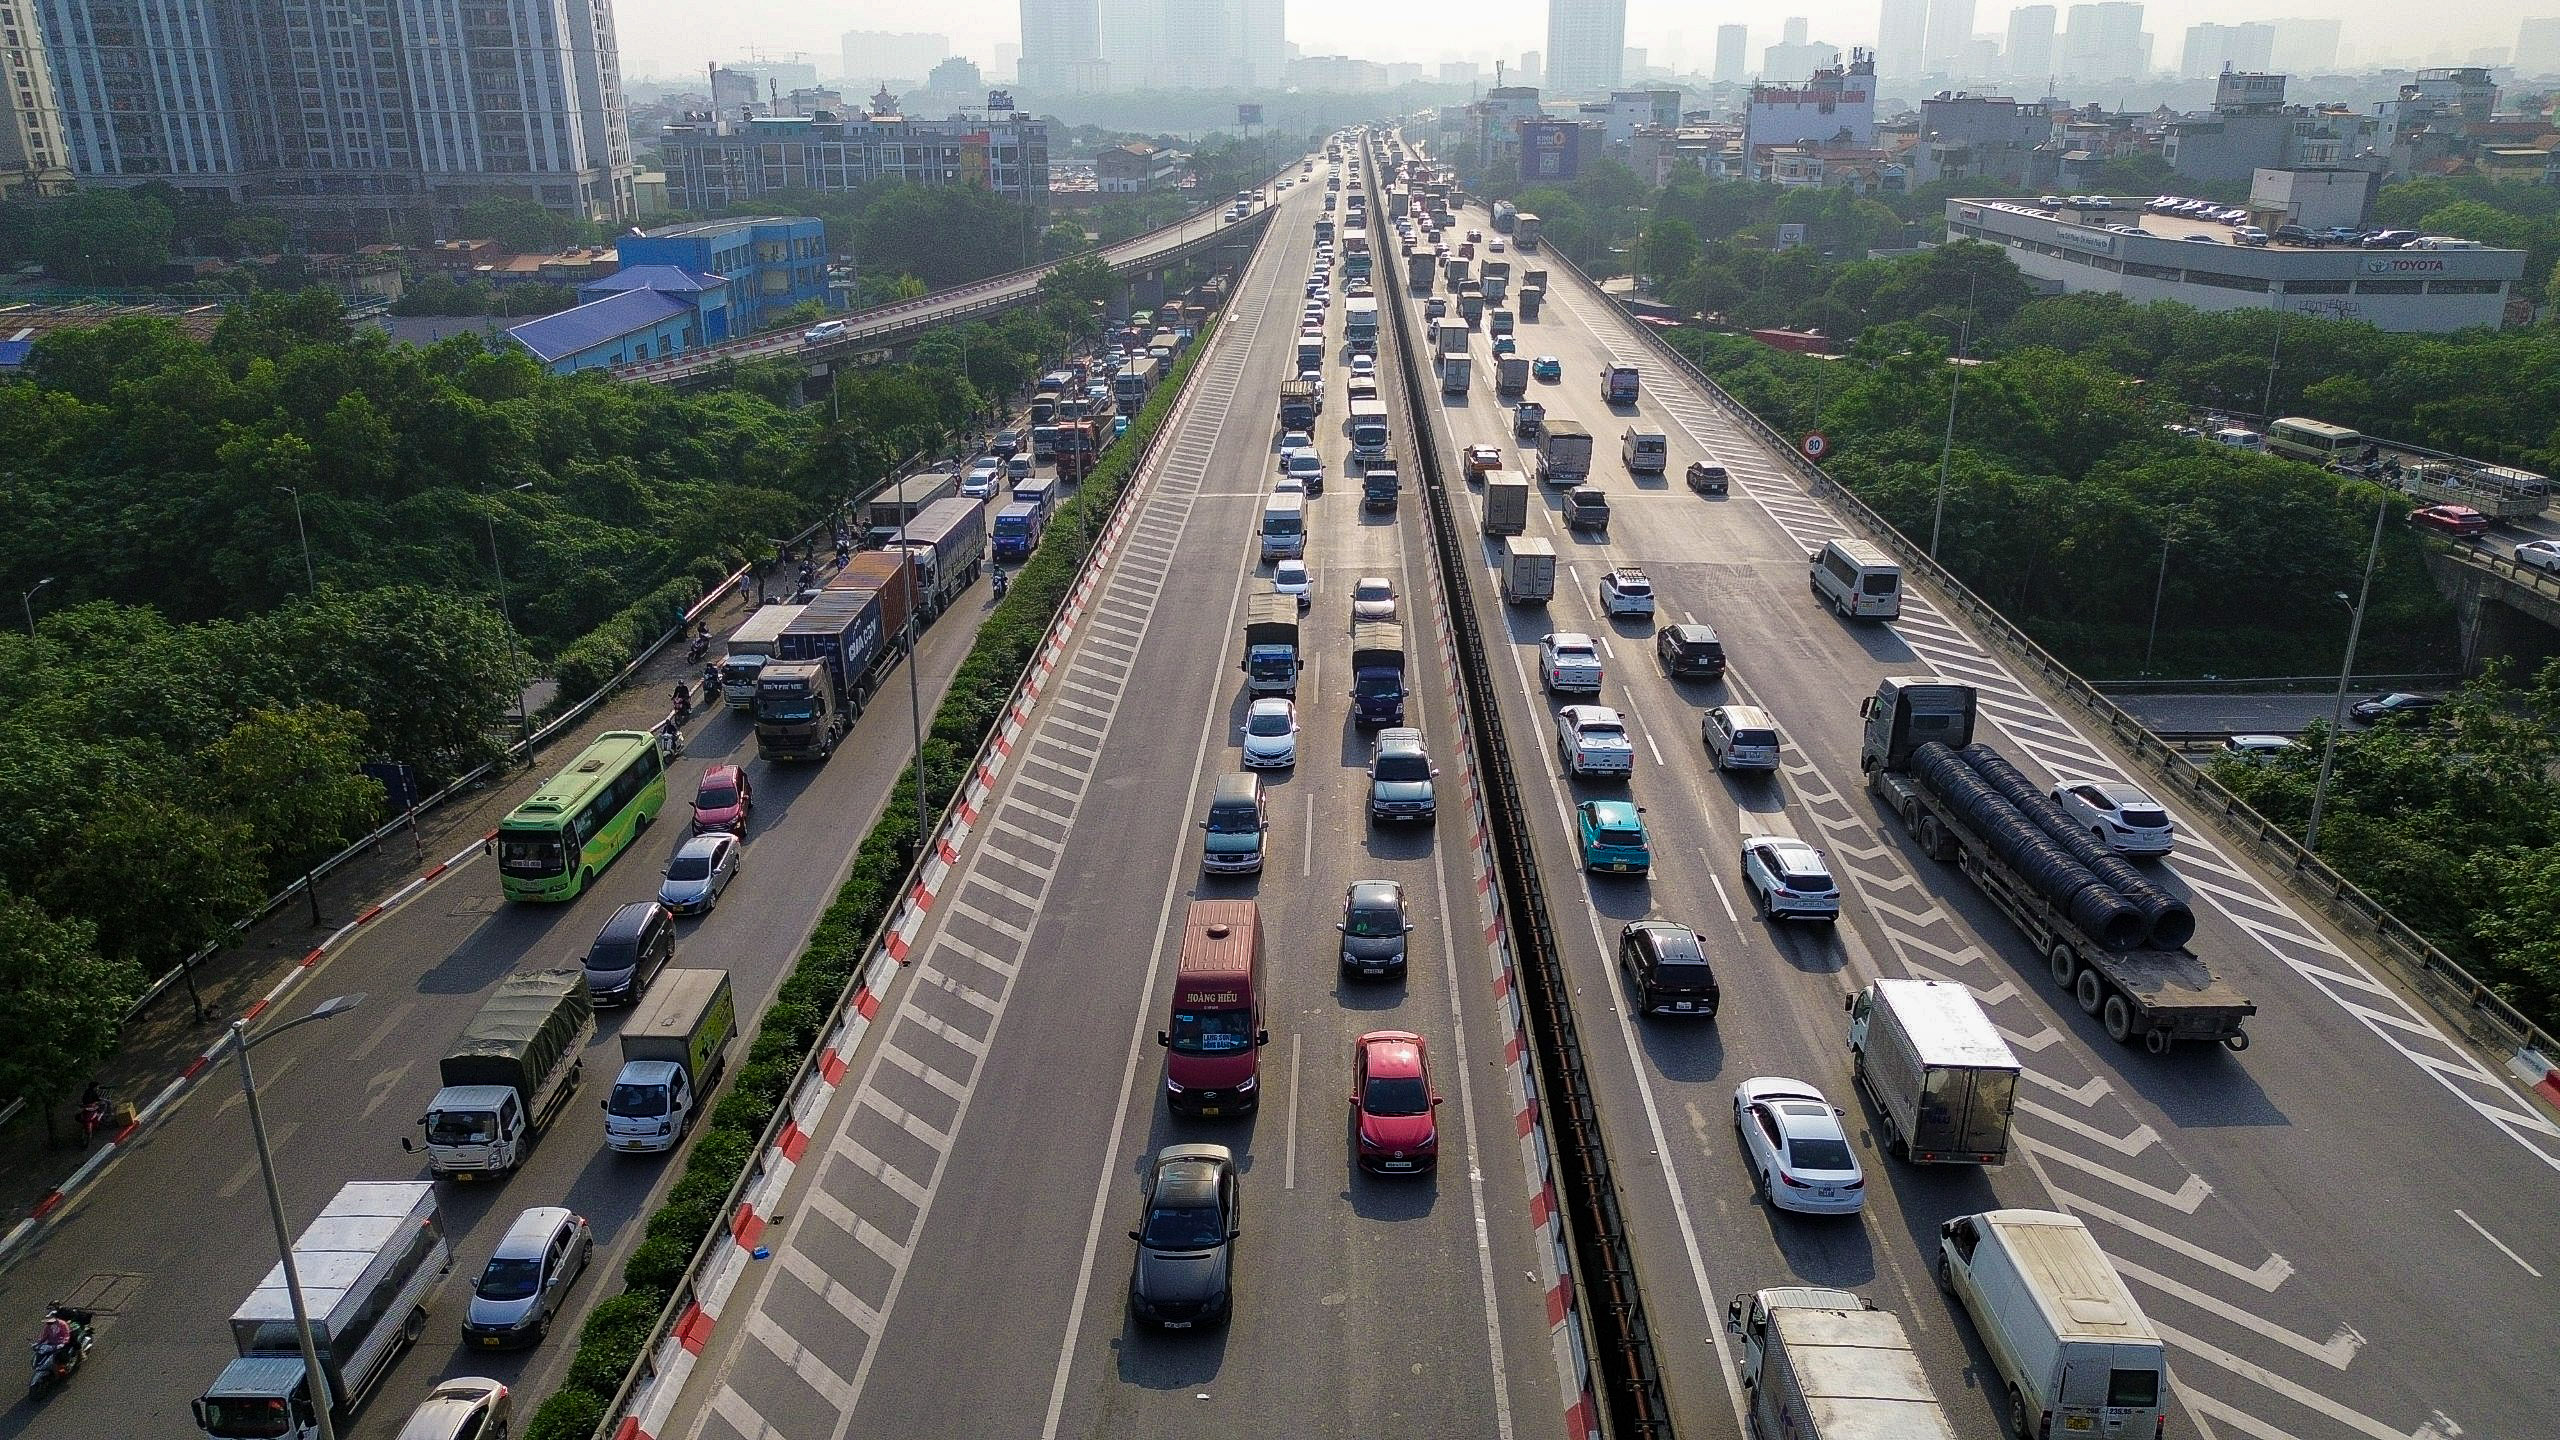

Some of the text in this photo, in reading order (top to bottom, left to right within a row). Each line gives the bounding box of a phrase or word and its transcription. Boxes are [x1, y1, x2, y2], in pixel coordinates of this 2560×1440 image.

[2391, 260, 2444, 271] TOYOTA
[1808, 440, 1821, 451] 80
[1187, 991, 1237, 1003] HOÀNG HIẾU
